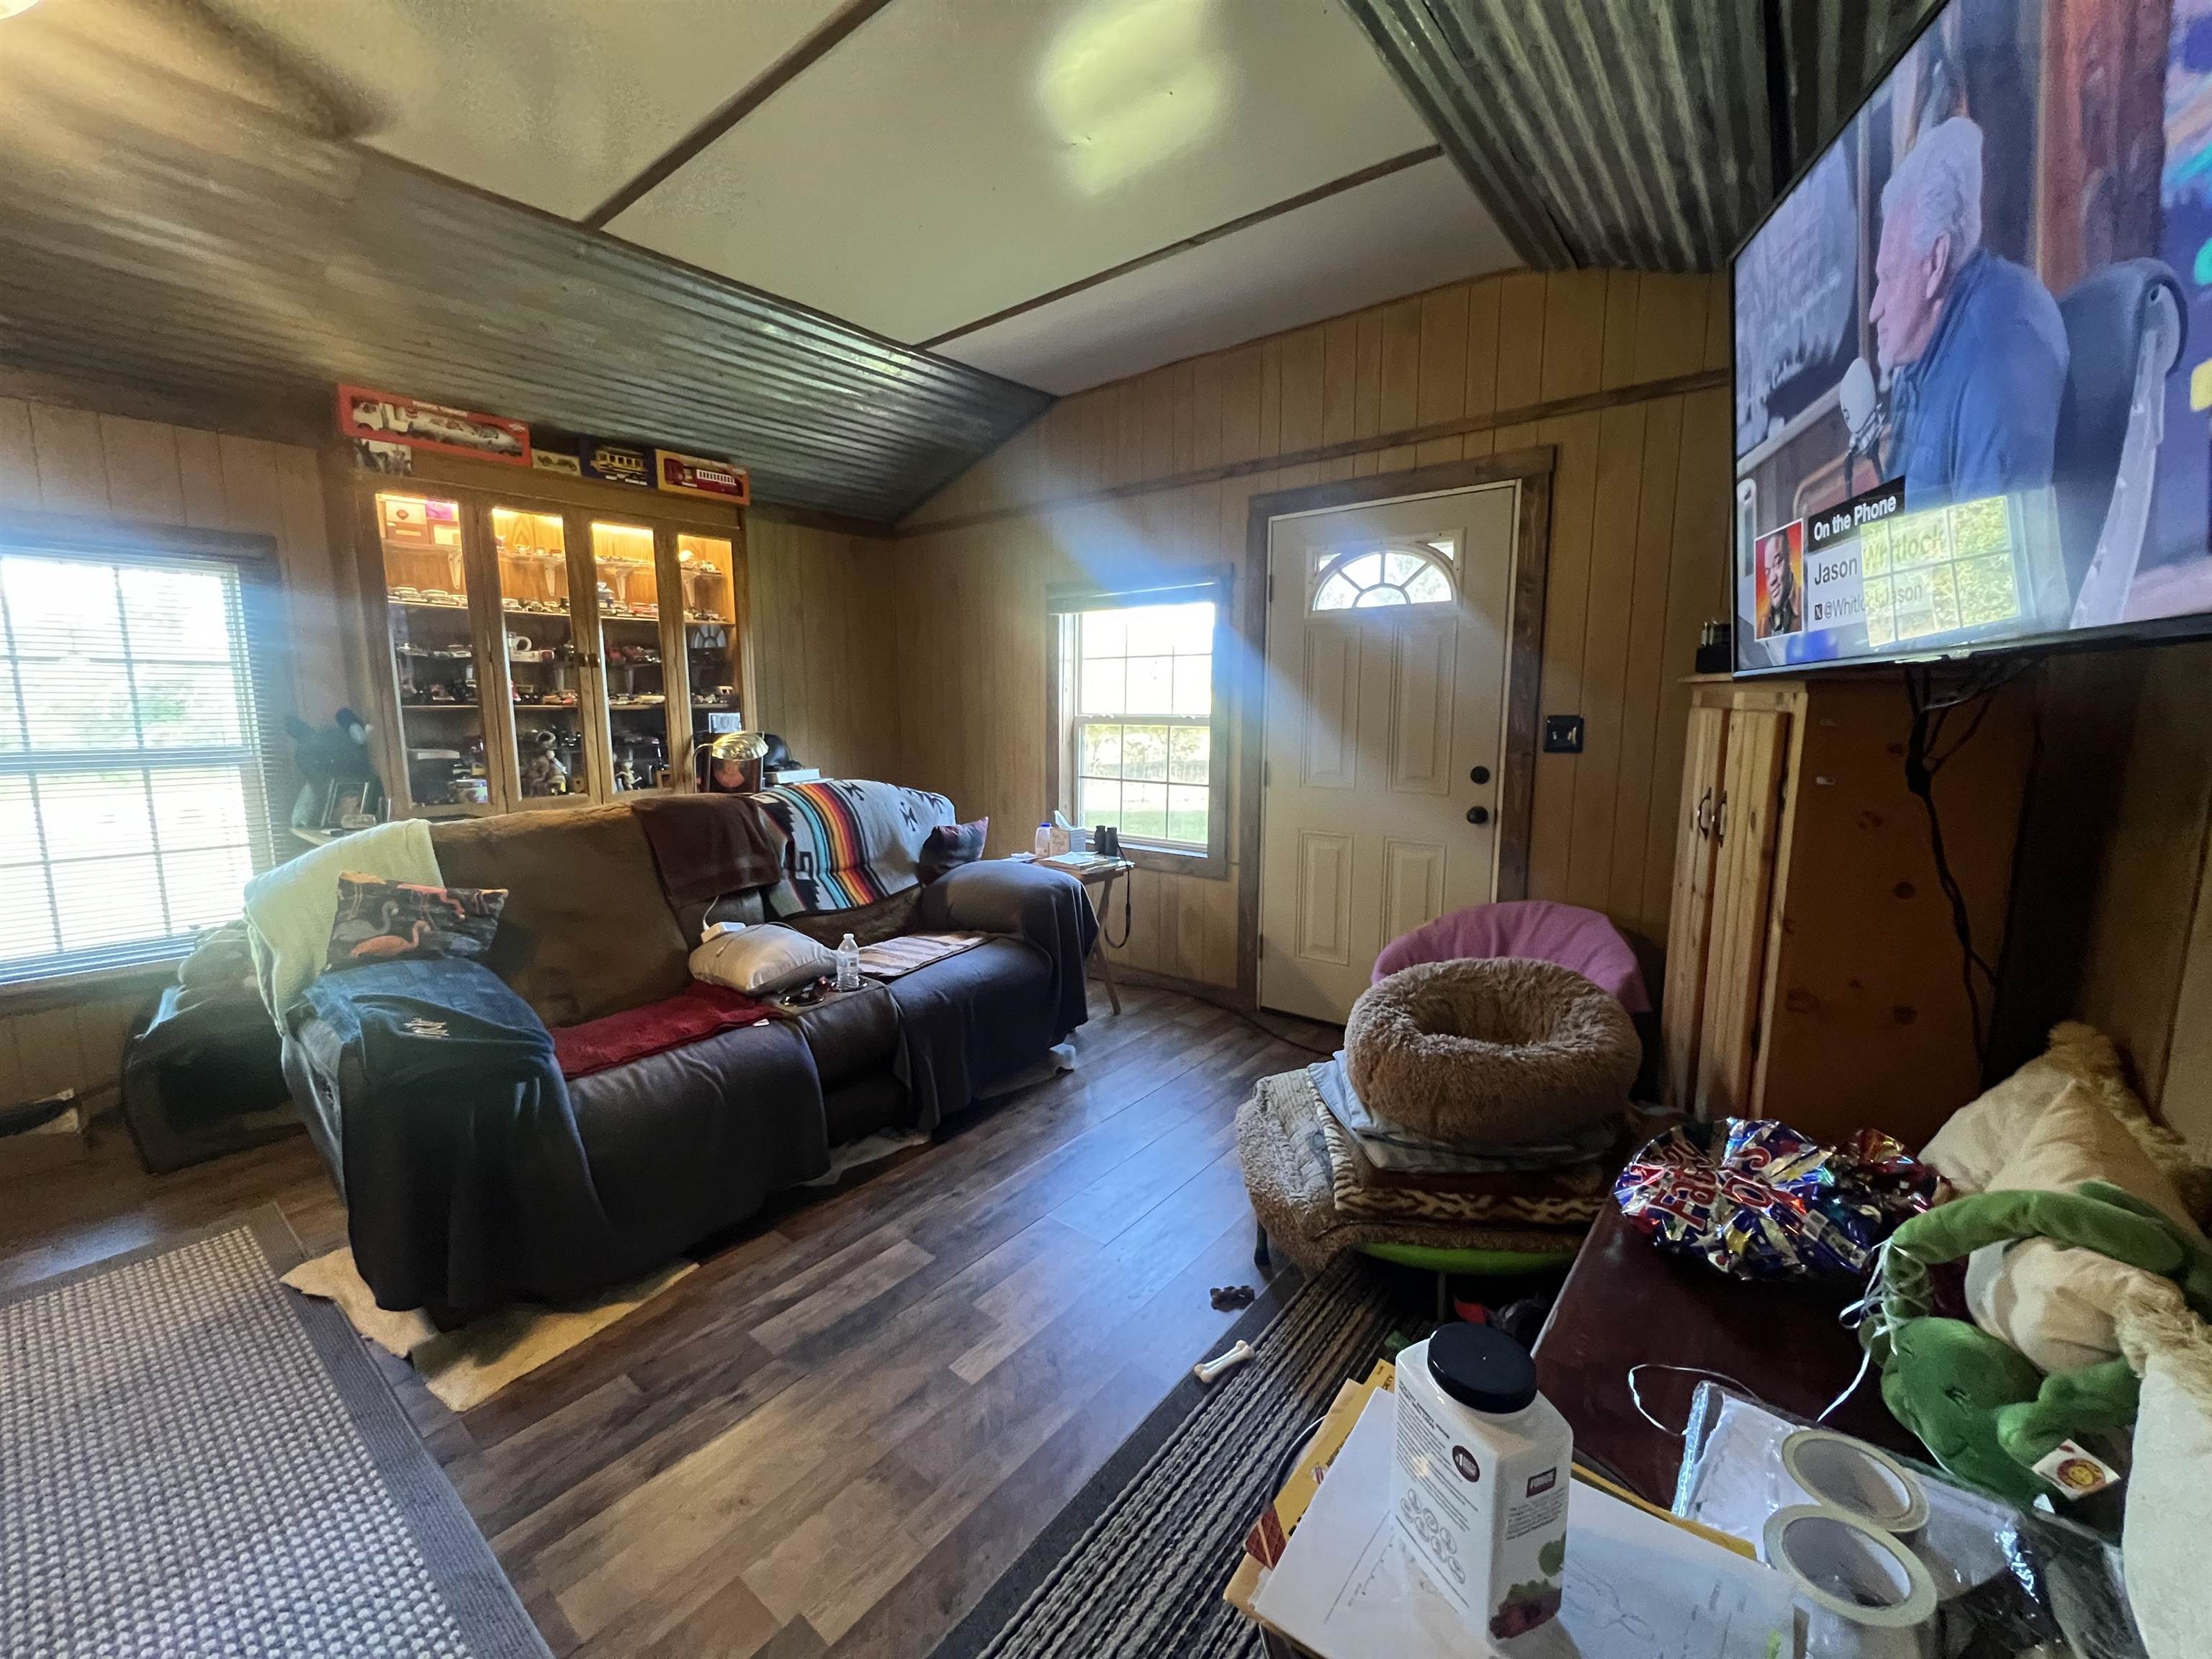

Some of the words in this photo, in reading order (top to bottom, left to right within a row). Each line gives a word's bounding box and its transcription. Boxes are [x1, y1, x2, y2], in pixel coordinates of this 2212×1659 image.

[1814, 521, 1830, 541] On
[1832, 514, 1851, 534] the
[1854, 495, 1897, 526] Phone
[1815, 557, 1858, 585] Jason
